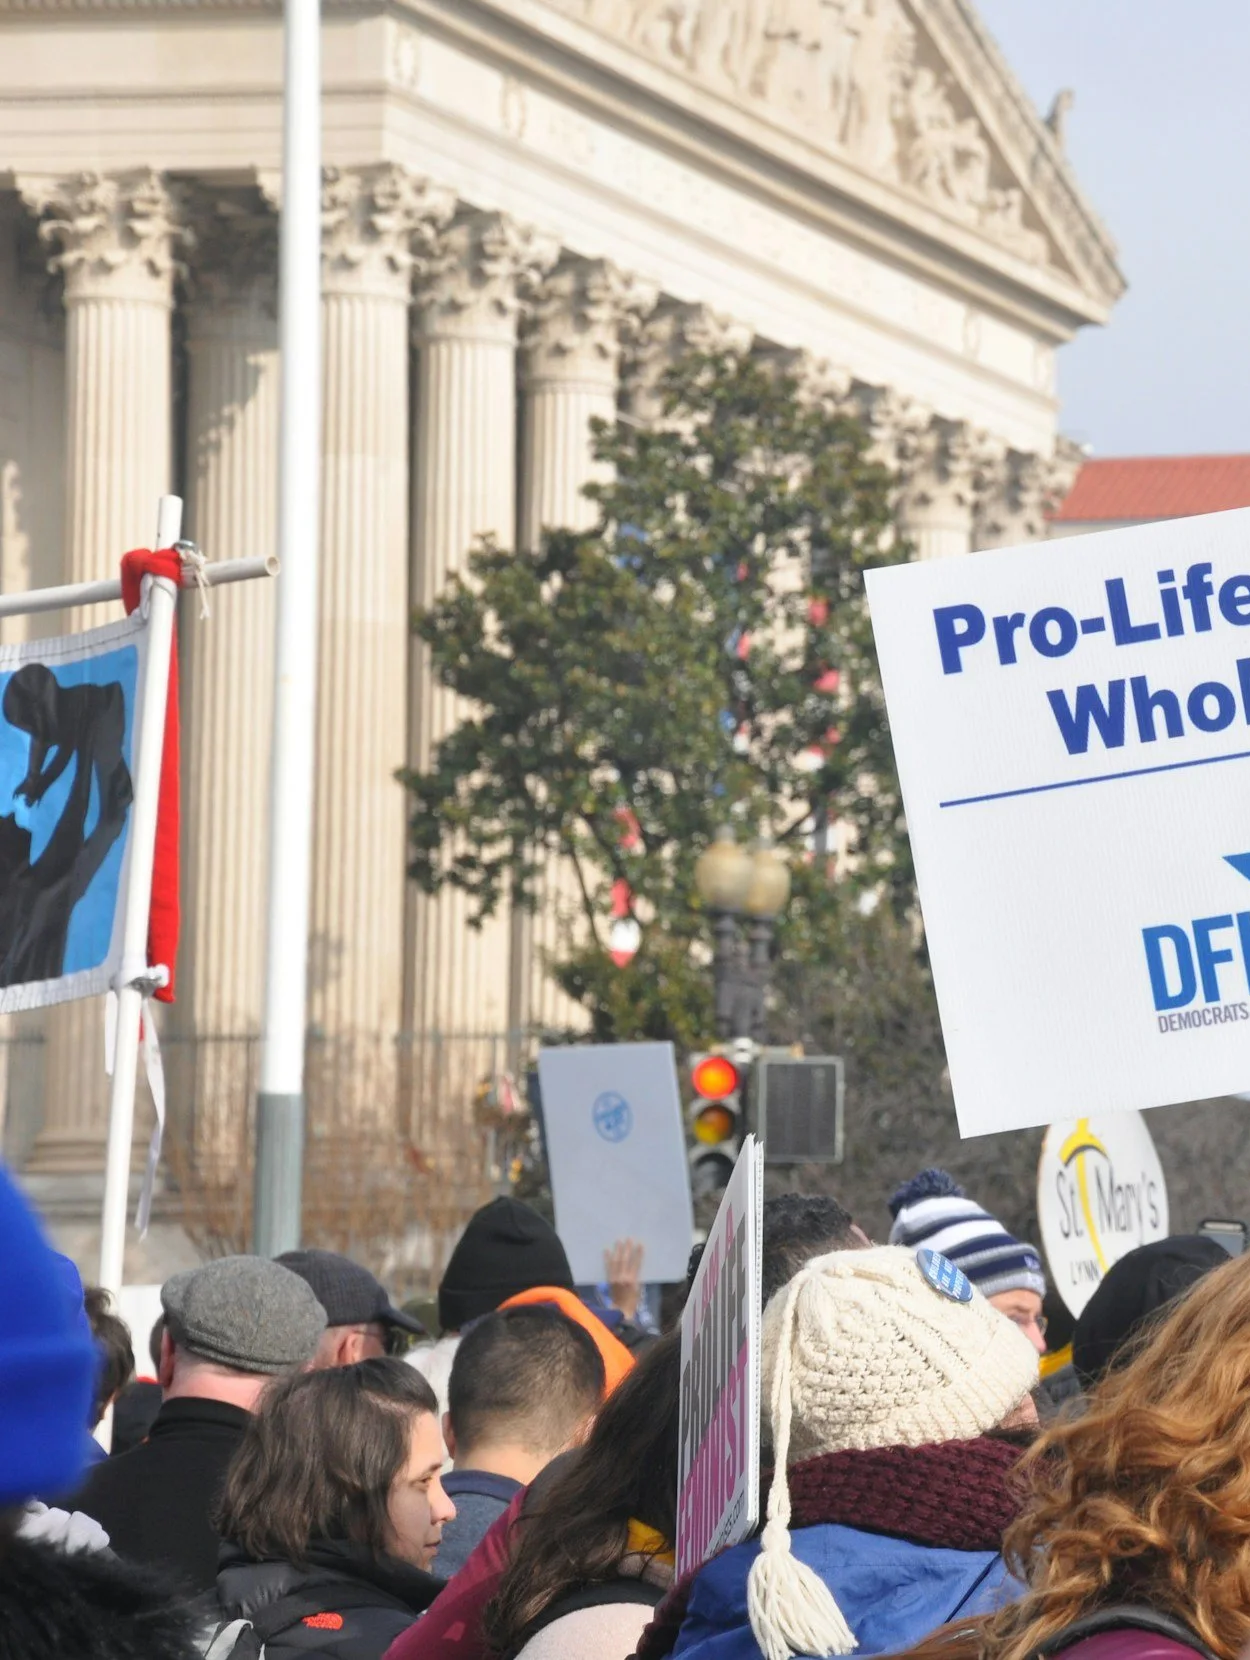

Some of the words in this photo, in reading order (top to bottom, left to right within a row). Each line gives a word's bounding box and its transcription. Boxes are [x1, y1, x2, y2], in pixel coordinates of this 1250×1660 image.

[1157, 1002, 1250, 1034] DEMOCRATS
[1094, 1163, 1160, 1247] Mary's
[681, 1211, 746, 1496] PROLIFE
[677, 1336, 748, 1581] FEMINIST
